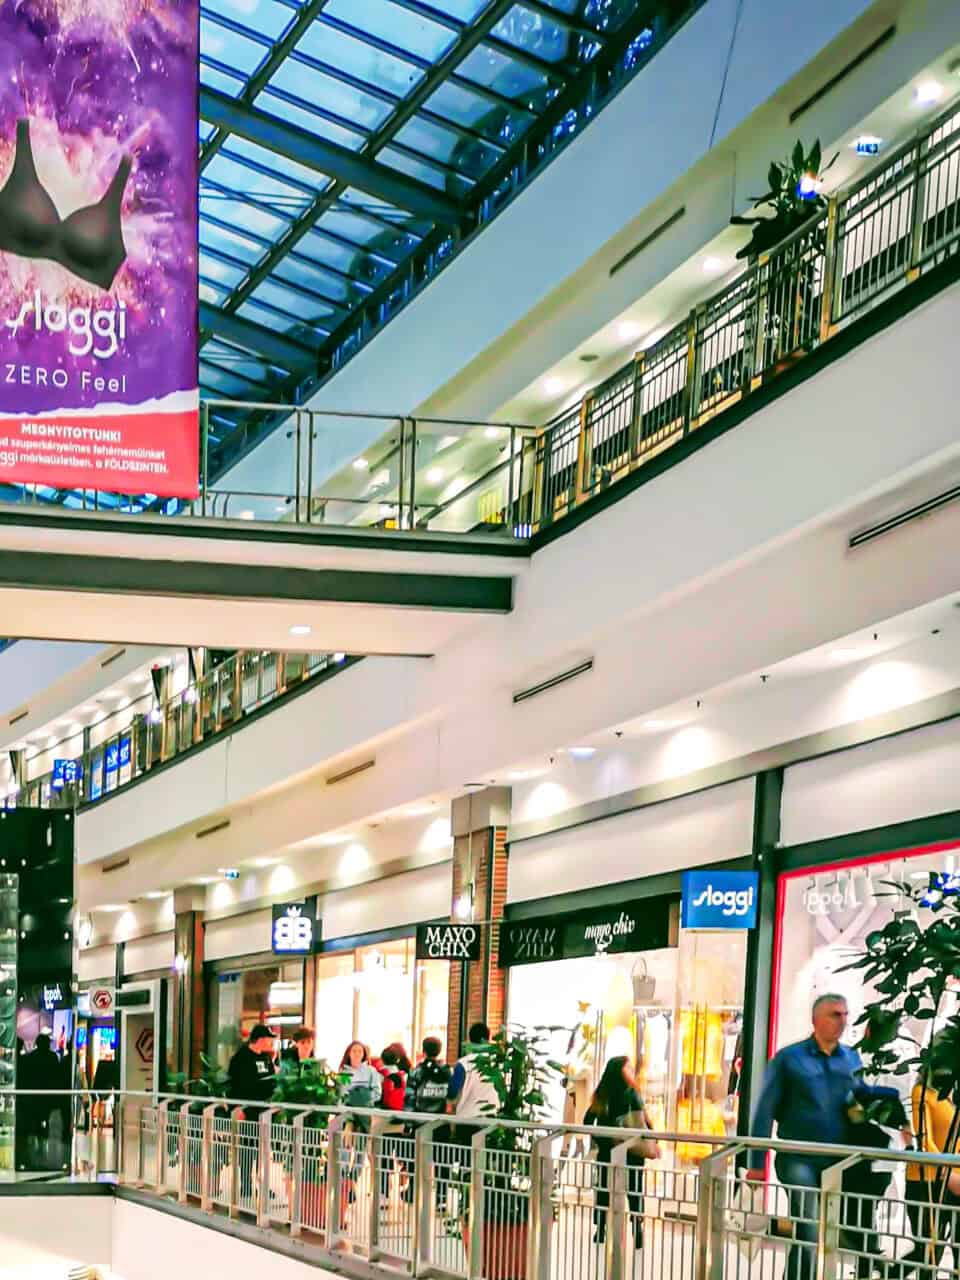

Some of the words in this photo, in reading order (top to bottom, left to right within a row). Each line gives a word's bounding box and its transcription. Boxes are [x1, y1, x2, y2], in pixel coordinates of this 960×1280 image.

[5, 288, 126, 358] sloggi
[5, 364, 68, 388] ZERO
[82, 371, 126, 392] Feel
[693, 885, 754, 916] sloggi
[425, 926, 476, 945] MAYO
[427, 942, 470, 958] CHIX
